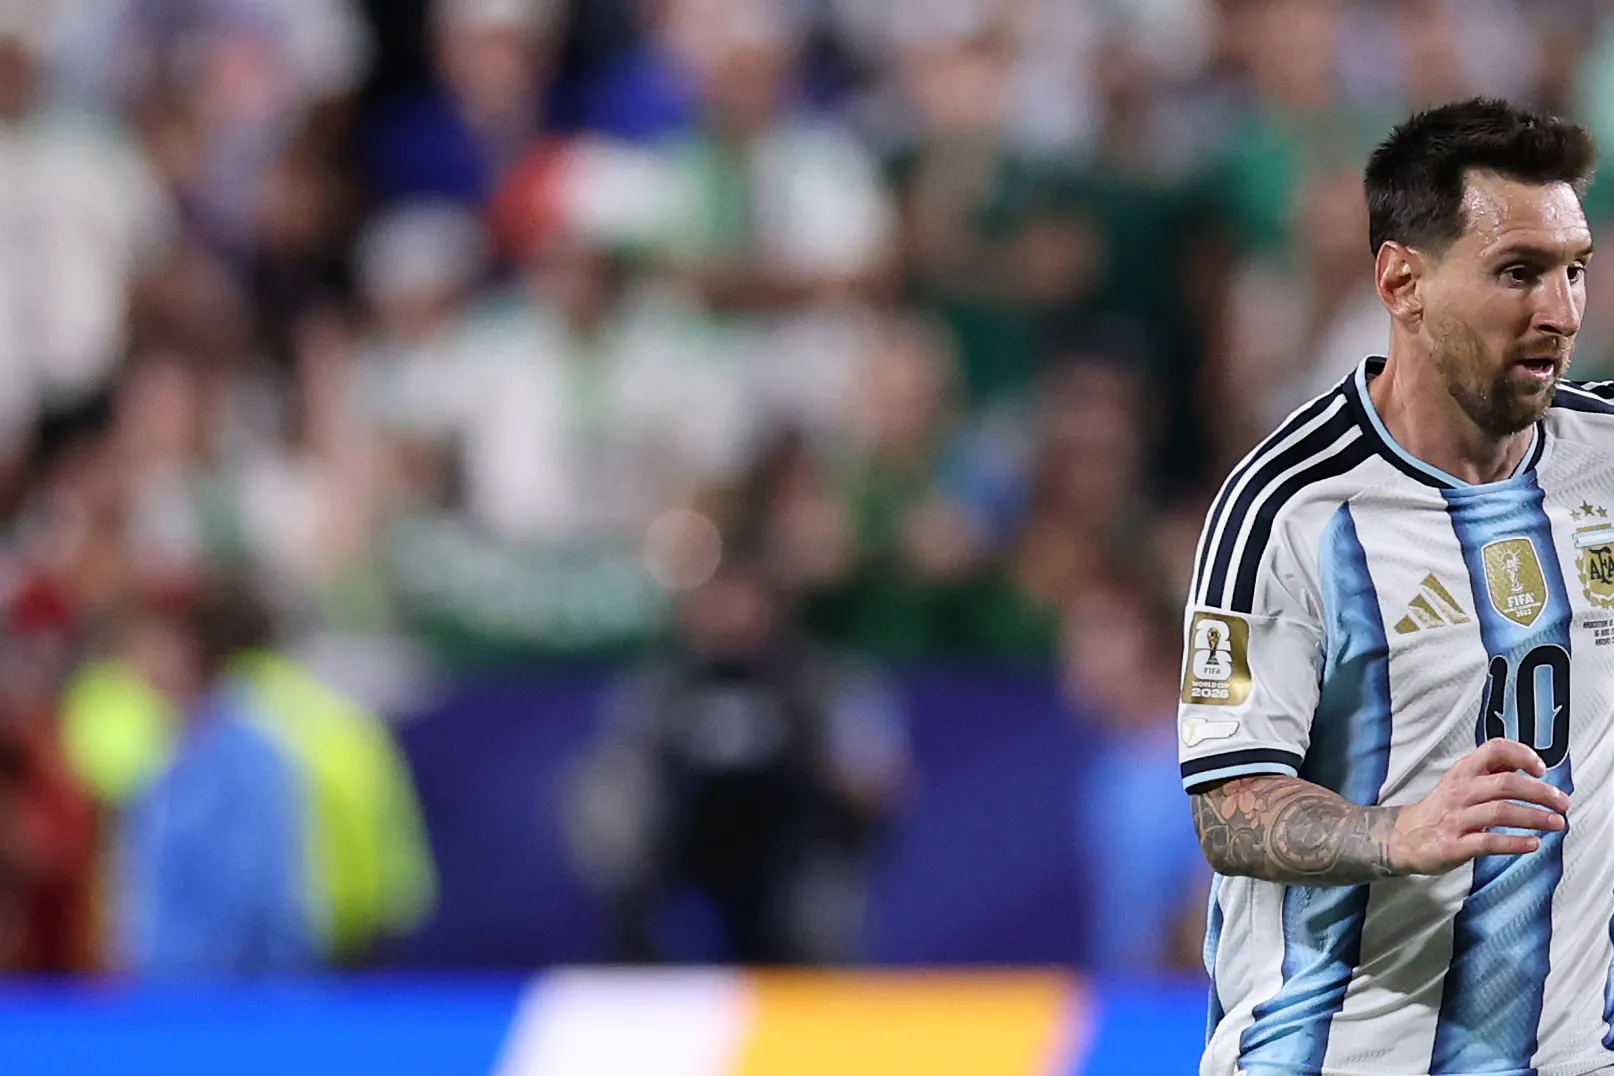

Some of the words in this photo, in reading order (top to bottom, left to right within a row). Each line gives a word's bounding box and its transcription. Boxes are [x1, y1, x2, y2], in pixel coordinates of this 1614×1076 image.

[1507, 593, 1534, 607] FIFA
[1204, 667, 1221, 675] FIFA
[1191, 688, 1230, 699] 2026
[1484, 644, 1571, 769] 10
